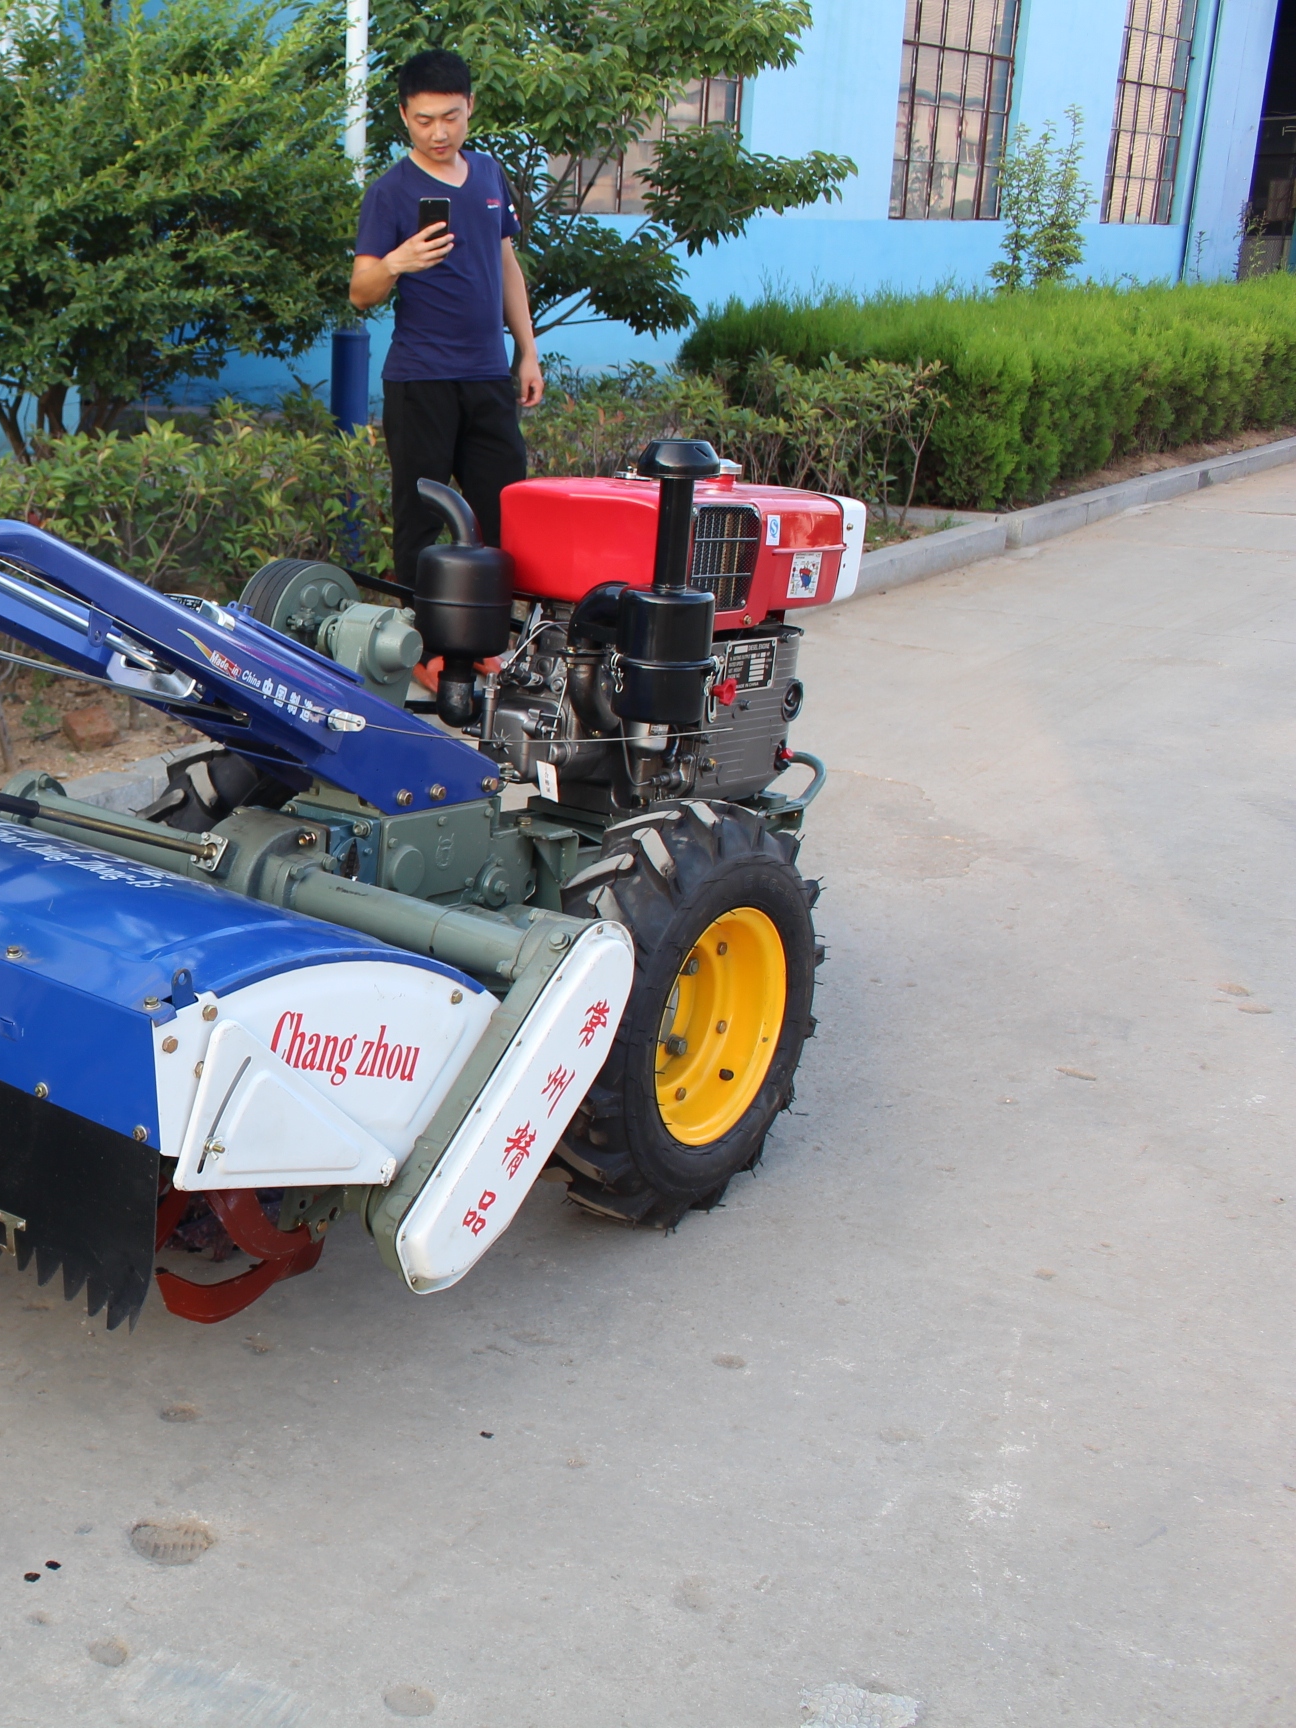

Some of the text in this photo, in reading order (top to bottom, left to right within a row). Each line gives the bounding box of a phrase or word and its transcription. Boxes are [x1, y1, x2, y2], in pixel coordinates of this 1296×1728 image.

[241, 669, 262, 688] China
[261, 677, 314, 723] 中国制造
[270, 1010, 420, 1086] Chang zhou
[462, 999, 610, 1237] 常州精品
